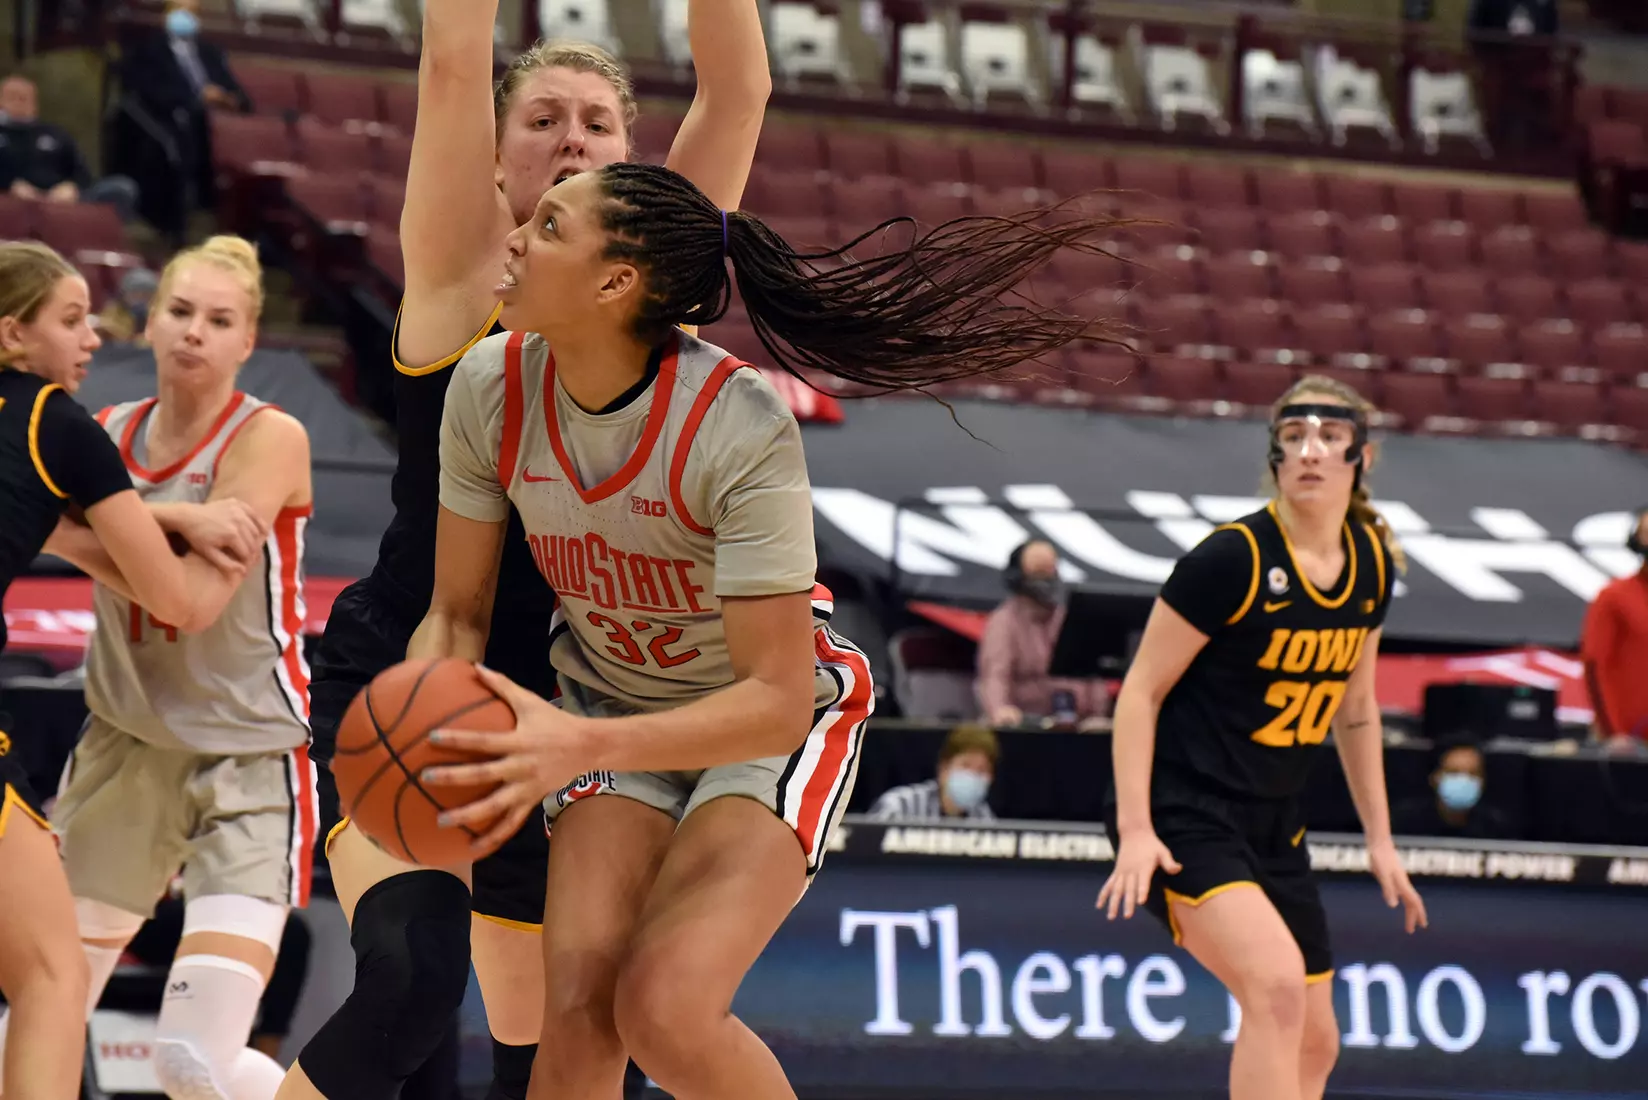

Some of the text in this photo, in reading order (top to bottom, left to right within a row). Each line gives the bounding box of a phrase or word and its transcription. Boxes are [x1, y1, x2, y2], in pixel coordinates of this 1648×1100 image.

[586, 611, 701, 668] 32
[1250, 680, 1347, 747] 20
[881, 826, 1017, 858] AMERICAN
[1019, 832, 1115, 861] ELECTR
[1485, 852, 1574, 882] POWER
[839, 904, 1187, 1043] There
[1339, 962, 1487, 1053] no
[1517, 970, 1648, 1059] ro
